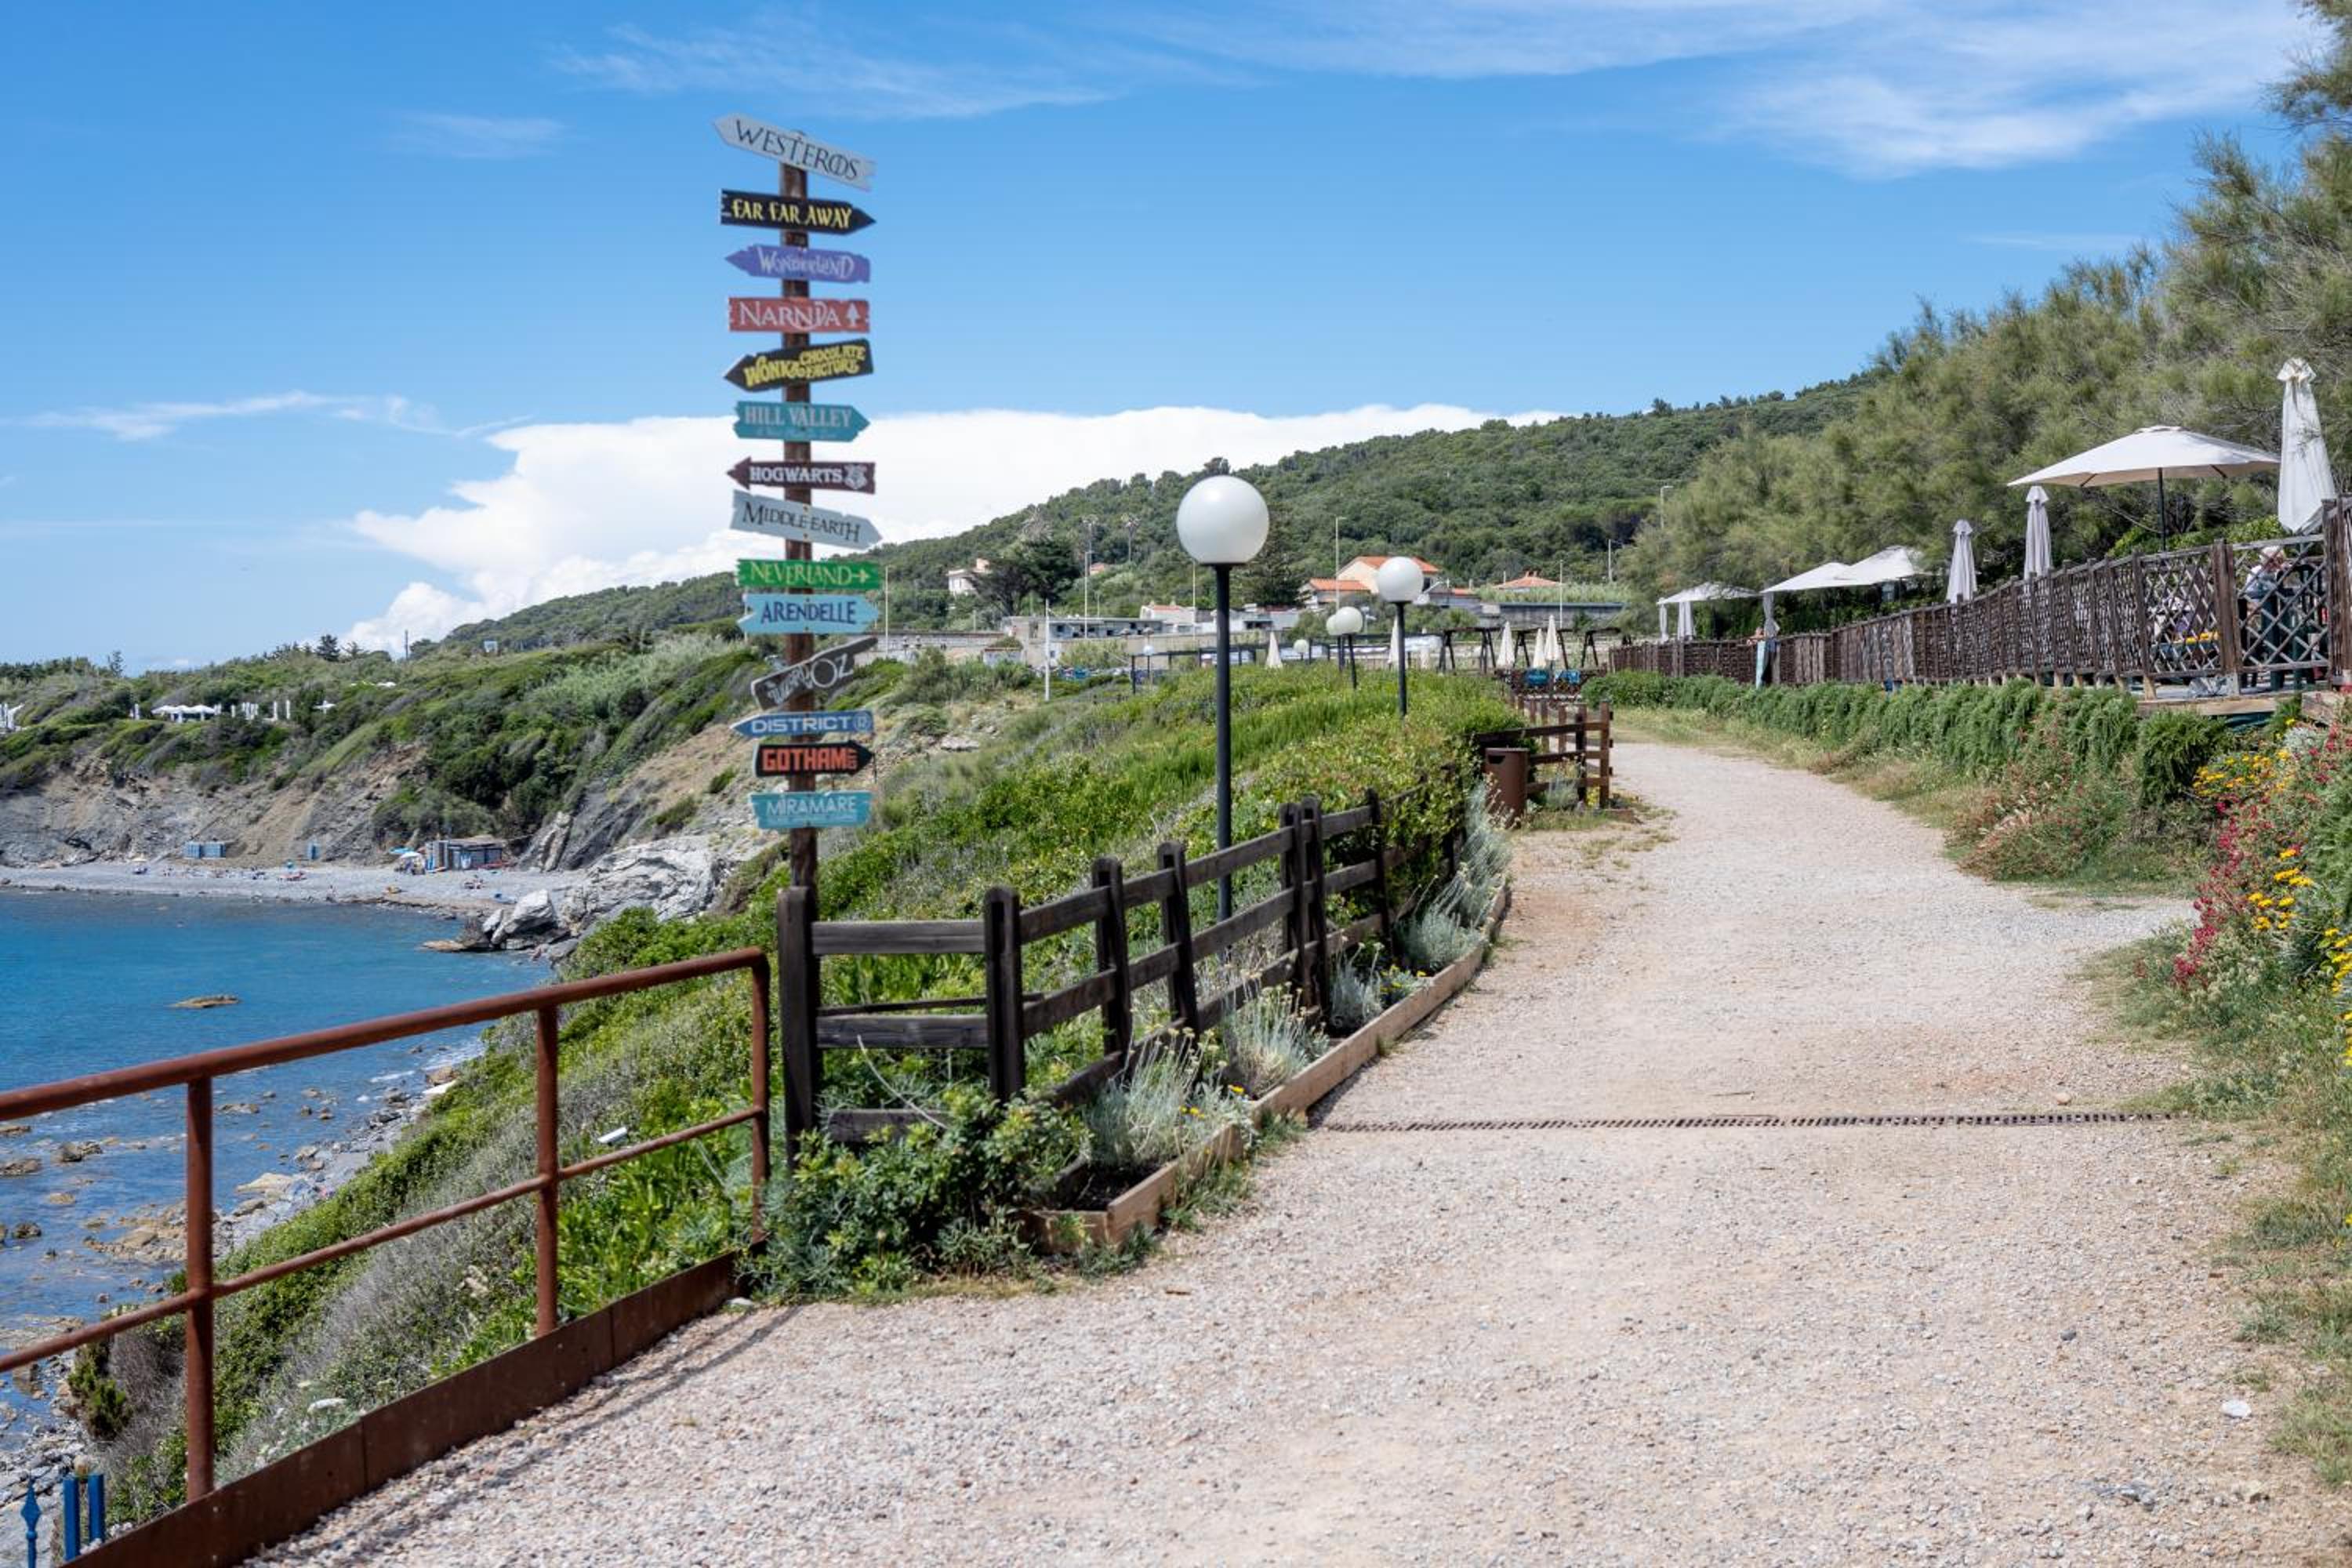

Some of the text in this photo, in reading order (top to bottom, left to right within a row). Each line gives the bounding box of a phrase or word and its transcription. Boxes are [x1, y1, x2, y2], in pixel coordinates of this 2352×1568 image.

[735, 119, 859, 180] WESTEROS
[731, 198, 852, 229] FAR FAR AWAY
[739, 300, 842, 331] NARNIA
[746, 405, 852, 427] HILL VALLEY
[750, 465, 843, 483] HOGWARTS
[750, 561, 852, 585] NEVERLAND
[760, 601, 857, 624] ARENDELLE
[752, 716, 851, 733] DISTRICT
[762, 748, 847, 771] GOTHAM
[766, 795, 857, 816] MIRAMARE
